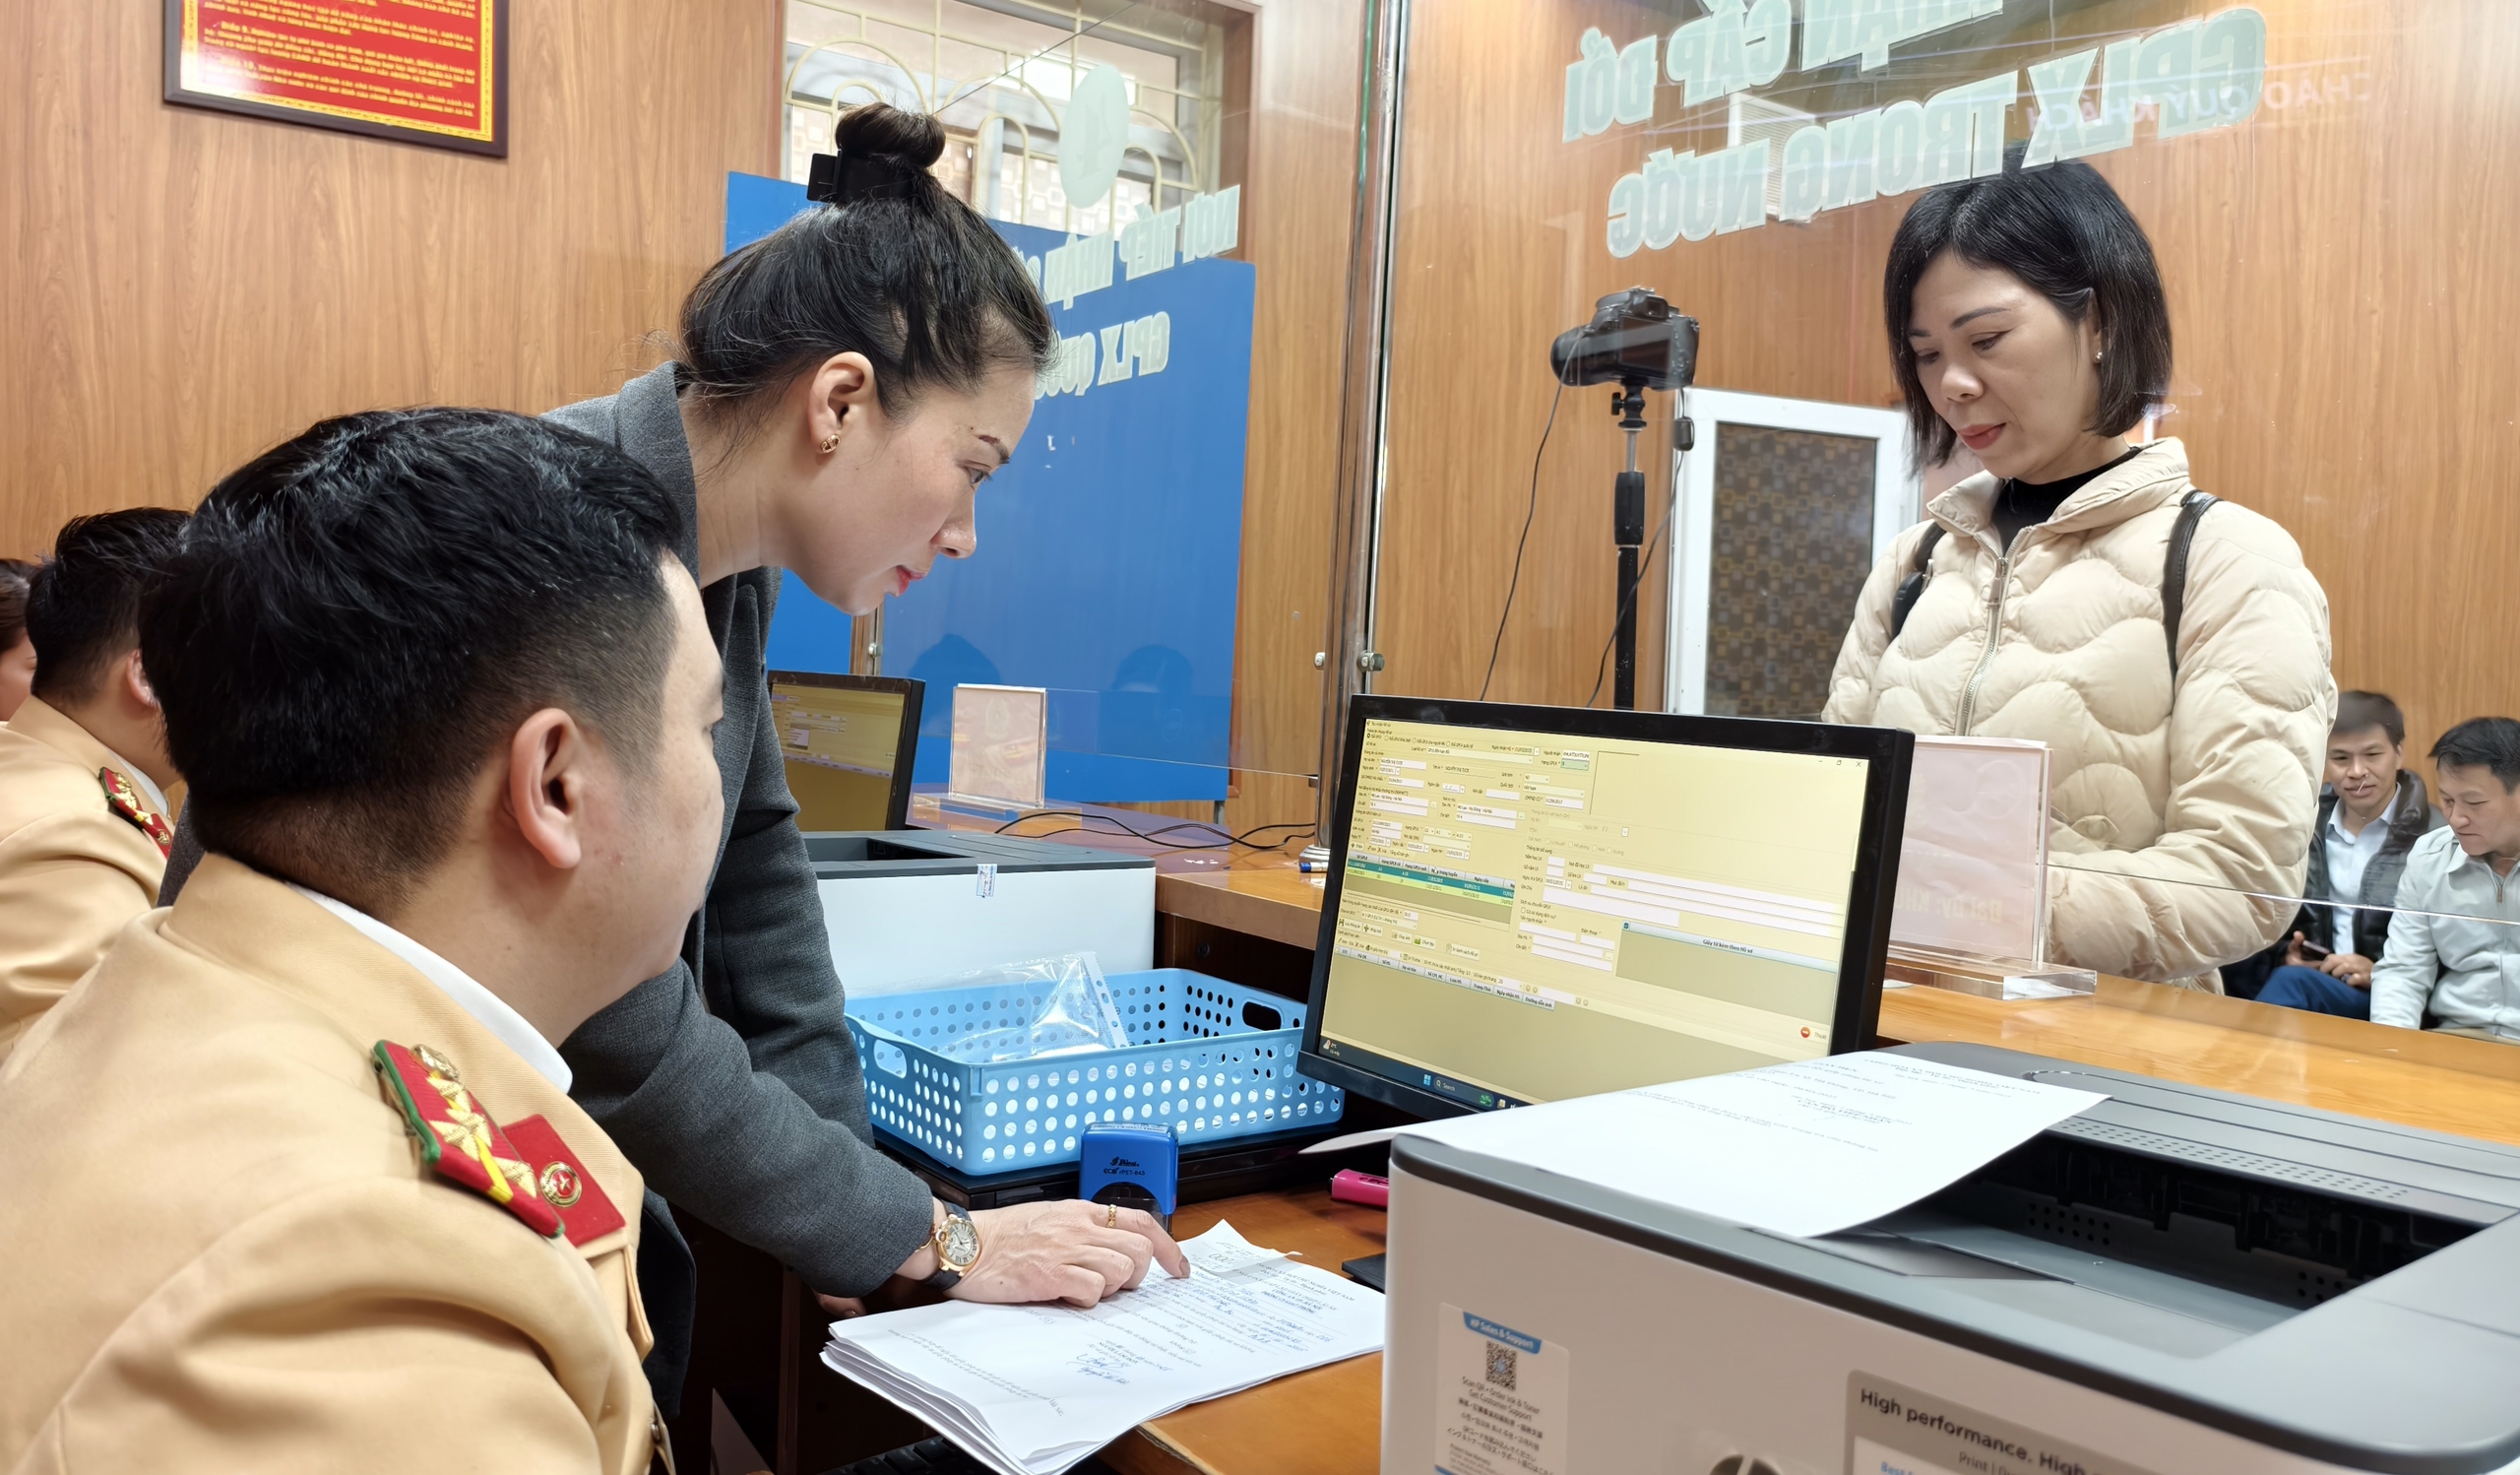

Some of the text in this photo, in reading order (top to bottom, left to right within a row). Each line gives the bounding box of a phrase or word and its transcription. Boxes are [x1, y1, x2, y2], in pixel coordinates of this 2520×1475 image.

[1859, 1387, 1902, 1417] High
[1906, 1406, 2034, 1465] performance.
[1958, 1450, 1988, 1473] Print
